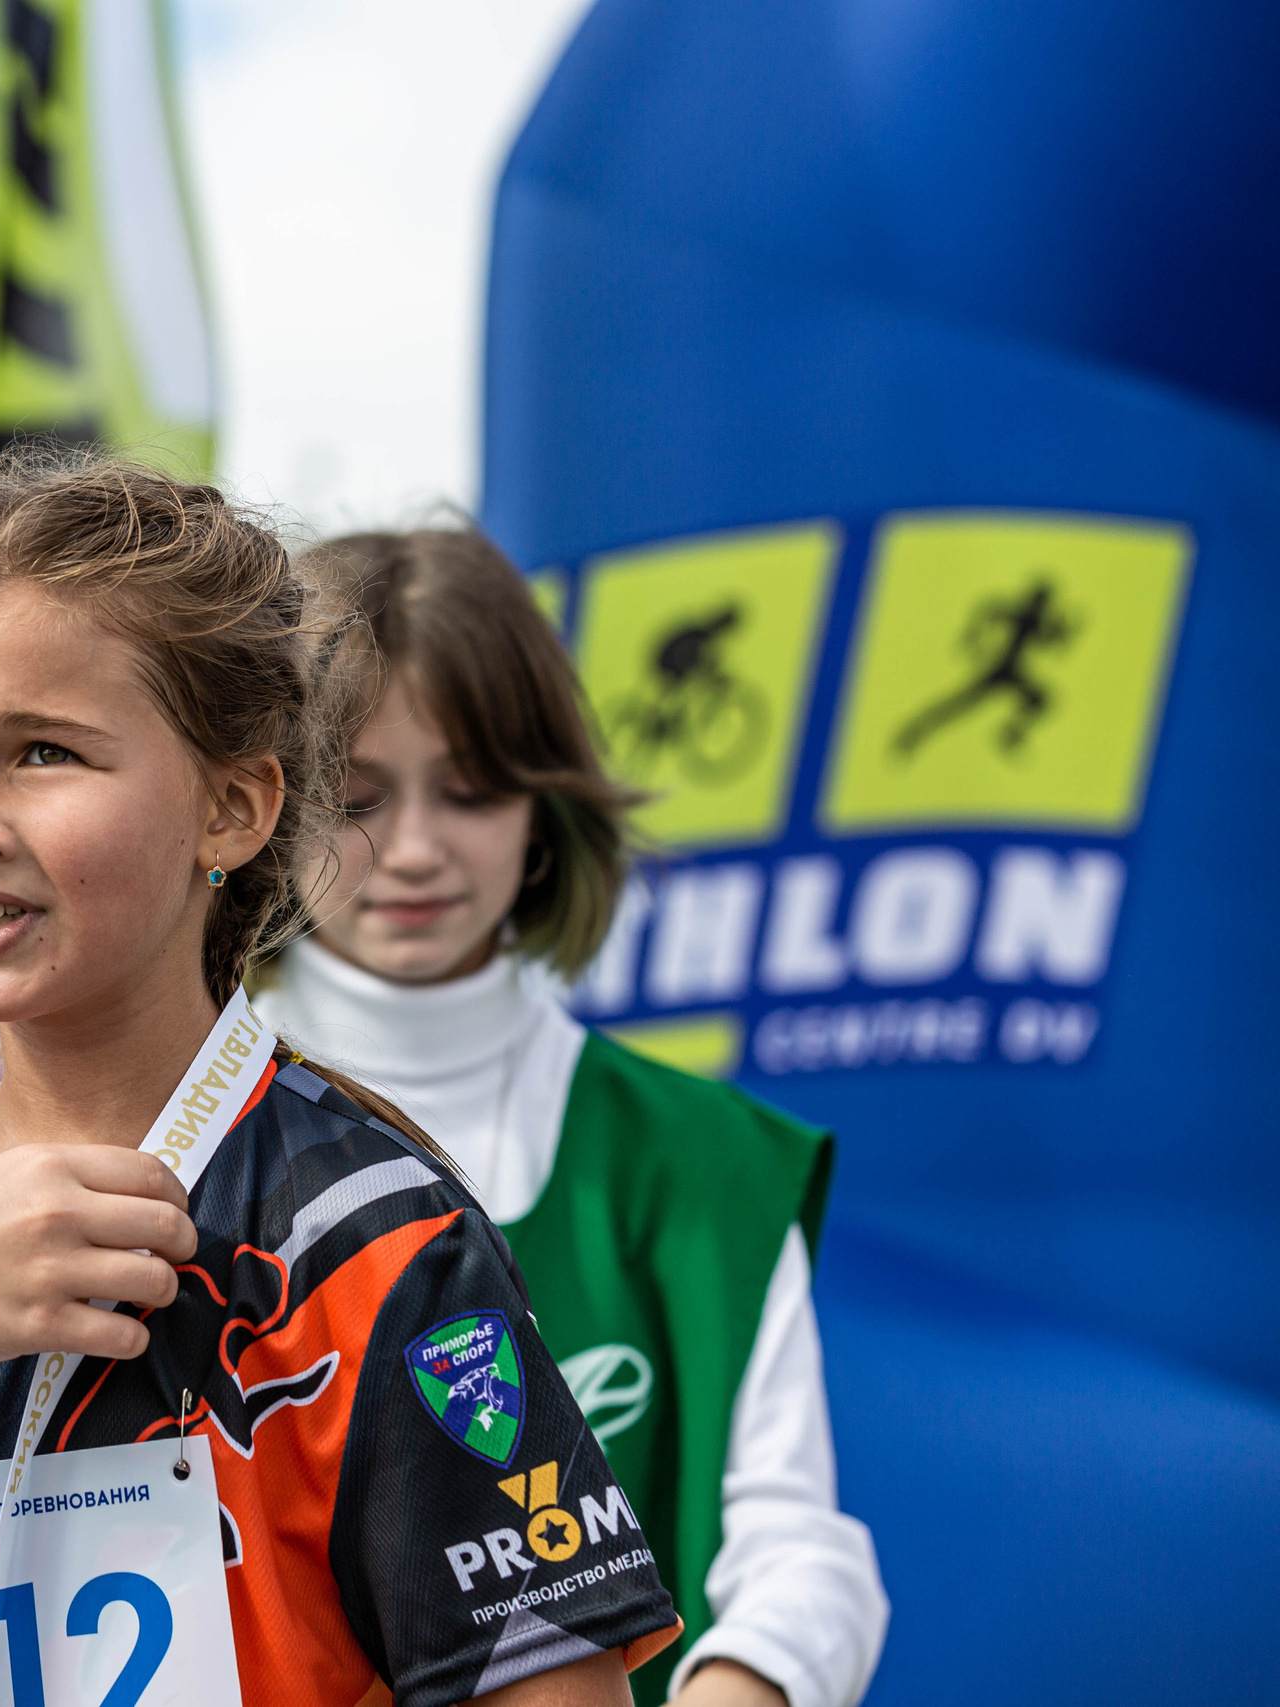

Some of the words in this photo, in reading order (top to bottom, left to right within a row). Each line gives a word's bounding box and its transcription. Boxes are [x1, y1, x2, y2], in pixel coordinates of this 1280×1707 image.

[582, 845, 1122, 1008] THLON
[422, 1323, 494, 1362] ПРИМОРЬЕ
[432, 1358, 451, 1375] ЗА
[452, 1340, 493, 1366] СПОРТ
[444, 1484, 641, 1592] PROM
[472, 1565, 606, 1625] ПРОИЗВОДСТВО
